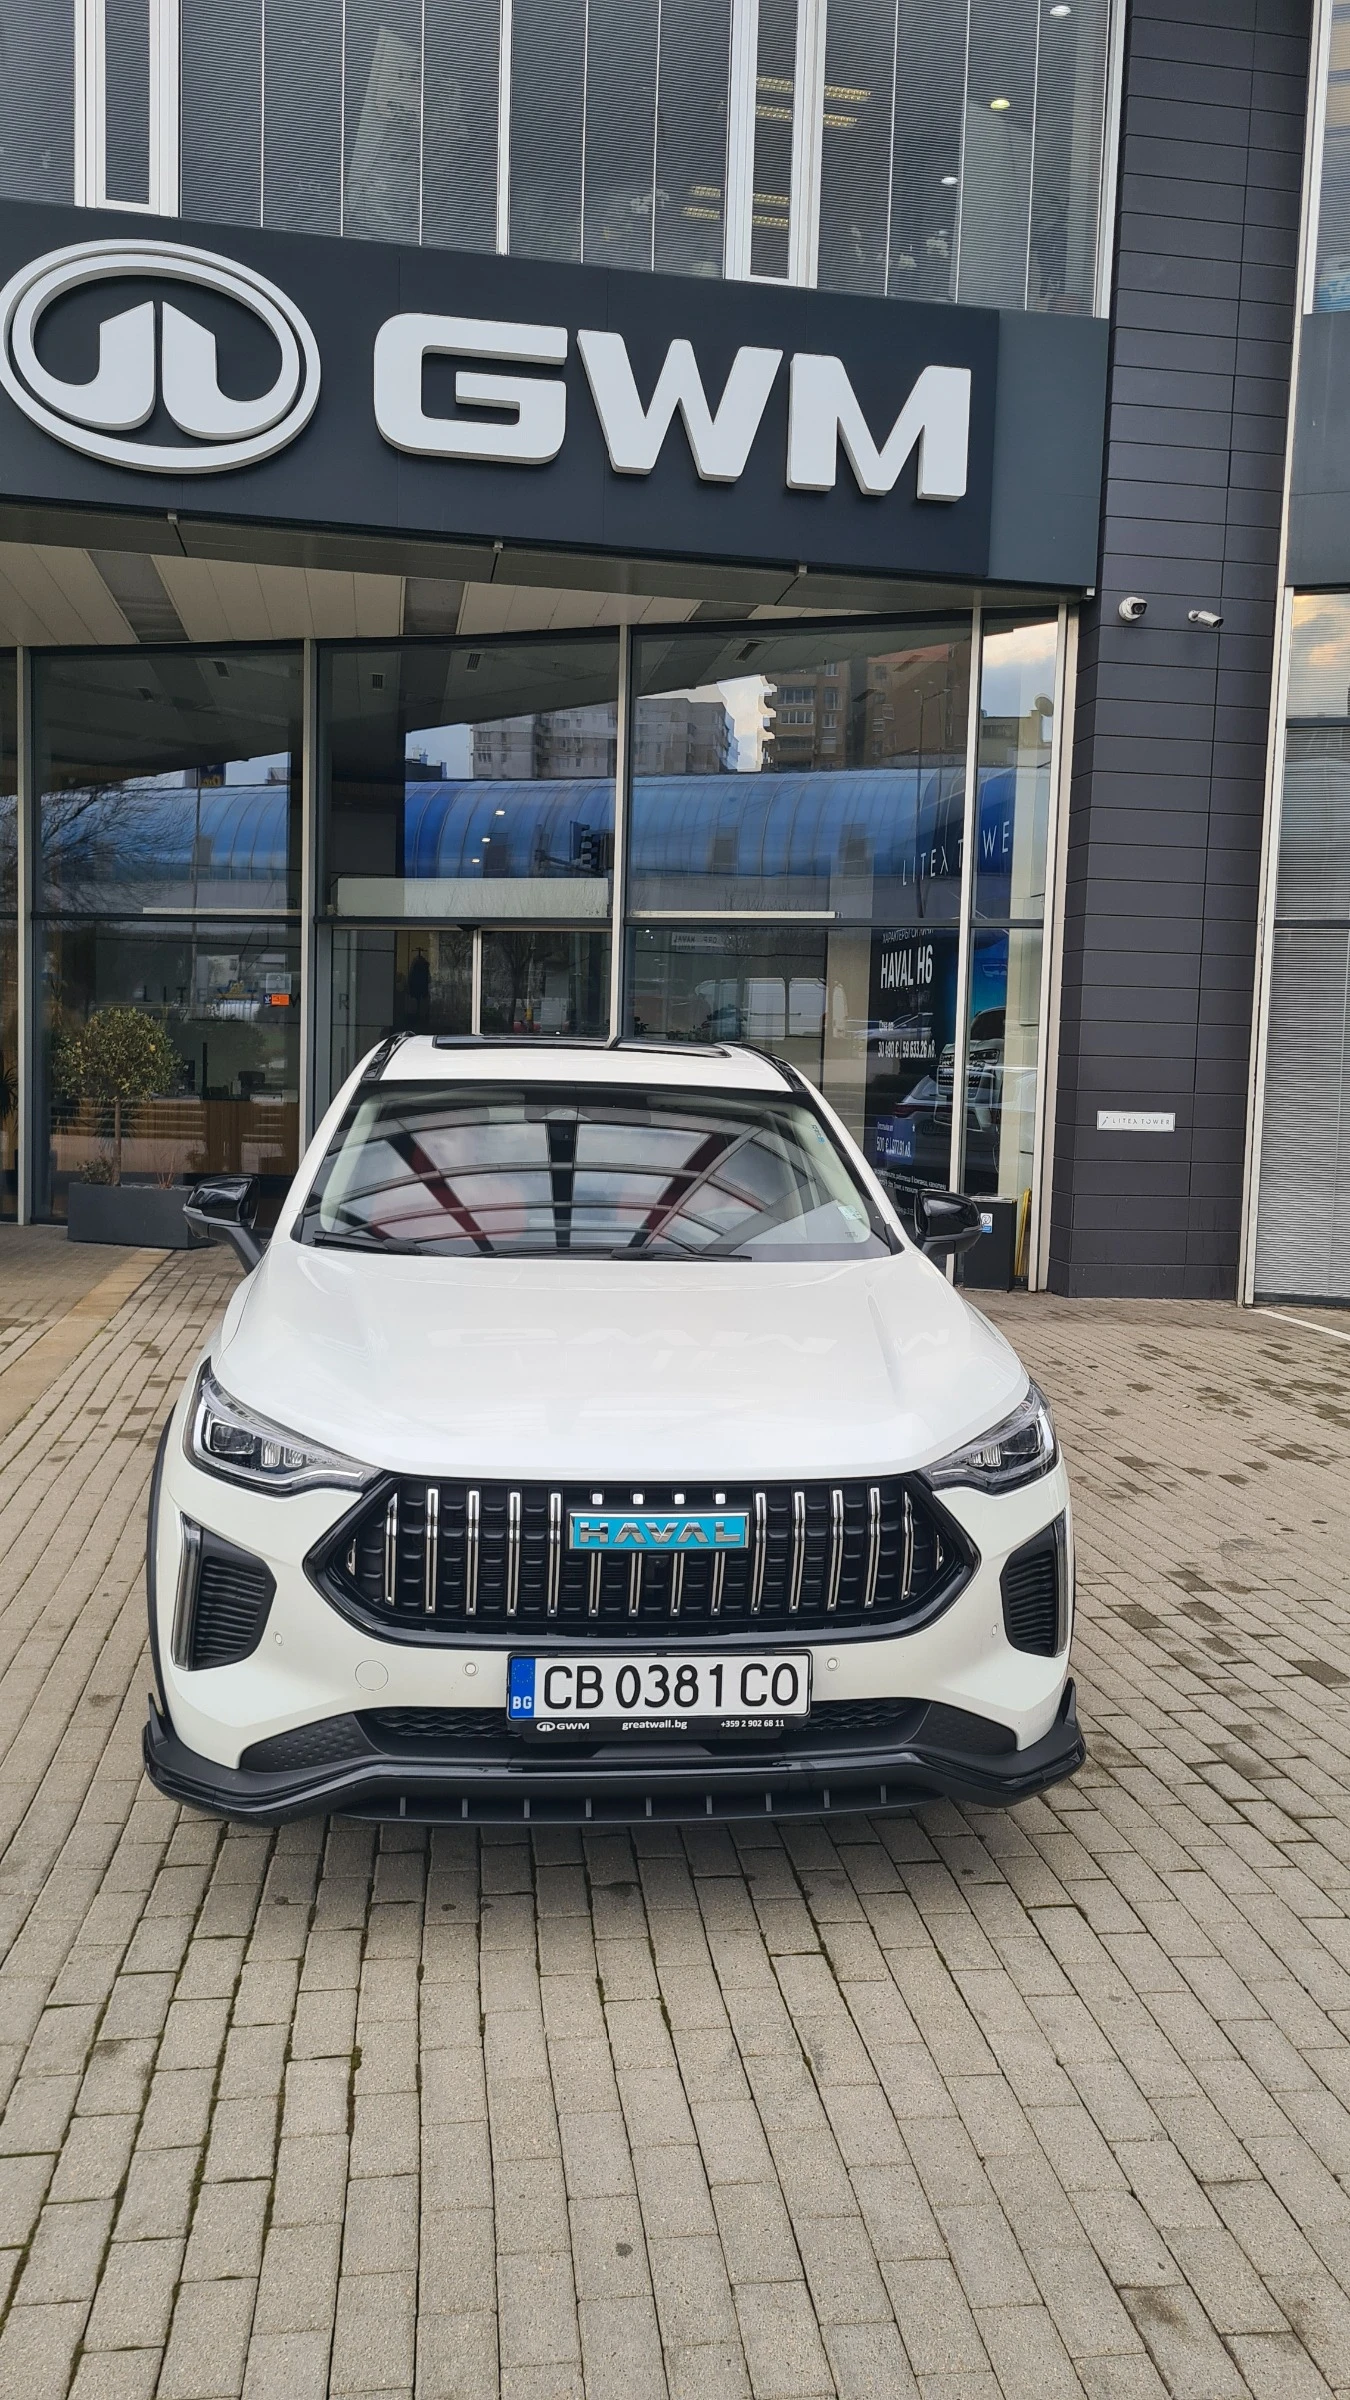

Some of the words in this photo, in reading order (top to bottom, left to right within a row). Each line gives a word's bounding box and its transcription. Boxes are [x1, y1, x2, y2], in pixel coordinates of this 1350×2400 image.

[374, 312, 972, 502] GWM
[880, 948, 914, 989] HAVAL
[917, 944, 933, 985] H6
[579, 1521, 741, 1543] HAVAL
[544, 1665, 604, 1709] CB
[615, 1664, 724, 1708] 0381
[740, 1663, 799, 1707] CO
[512, 1696, 532, 1710] BG
[556, 1722, 590, 1730] GWM
[621, 1719, 688, 1731] greatwall.bg
[720, 1720, 740, 1728] +359
